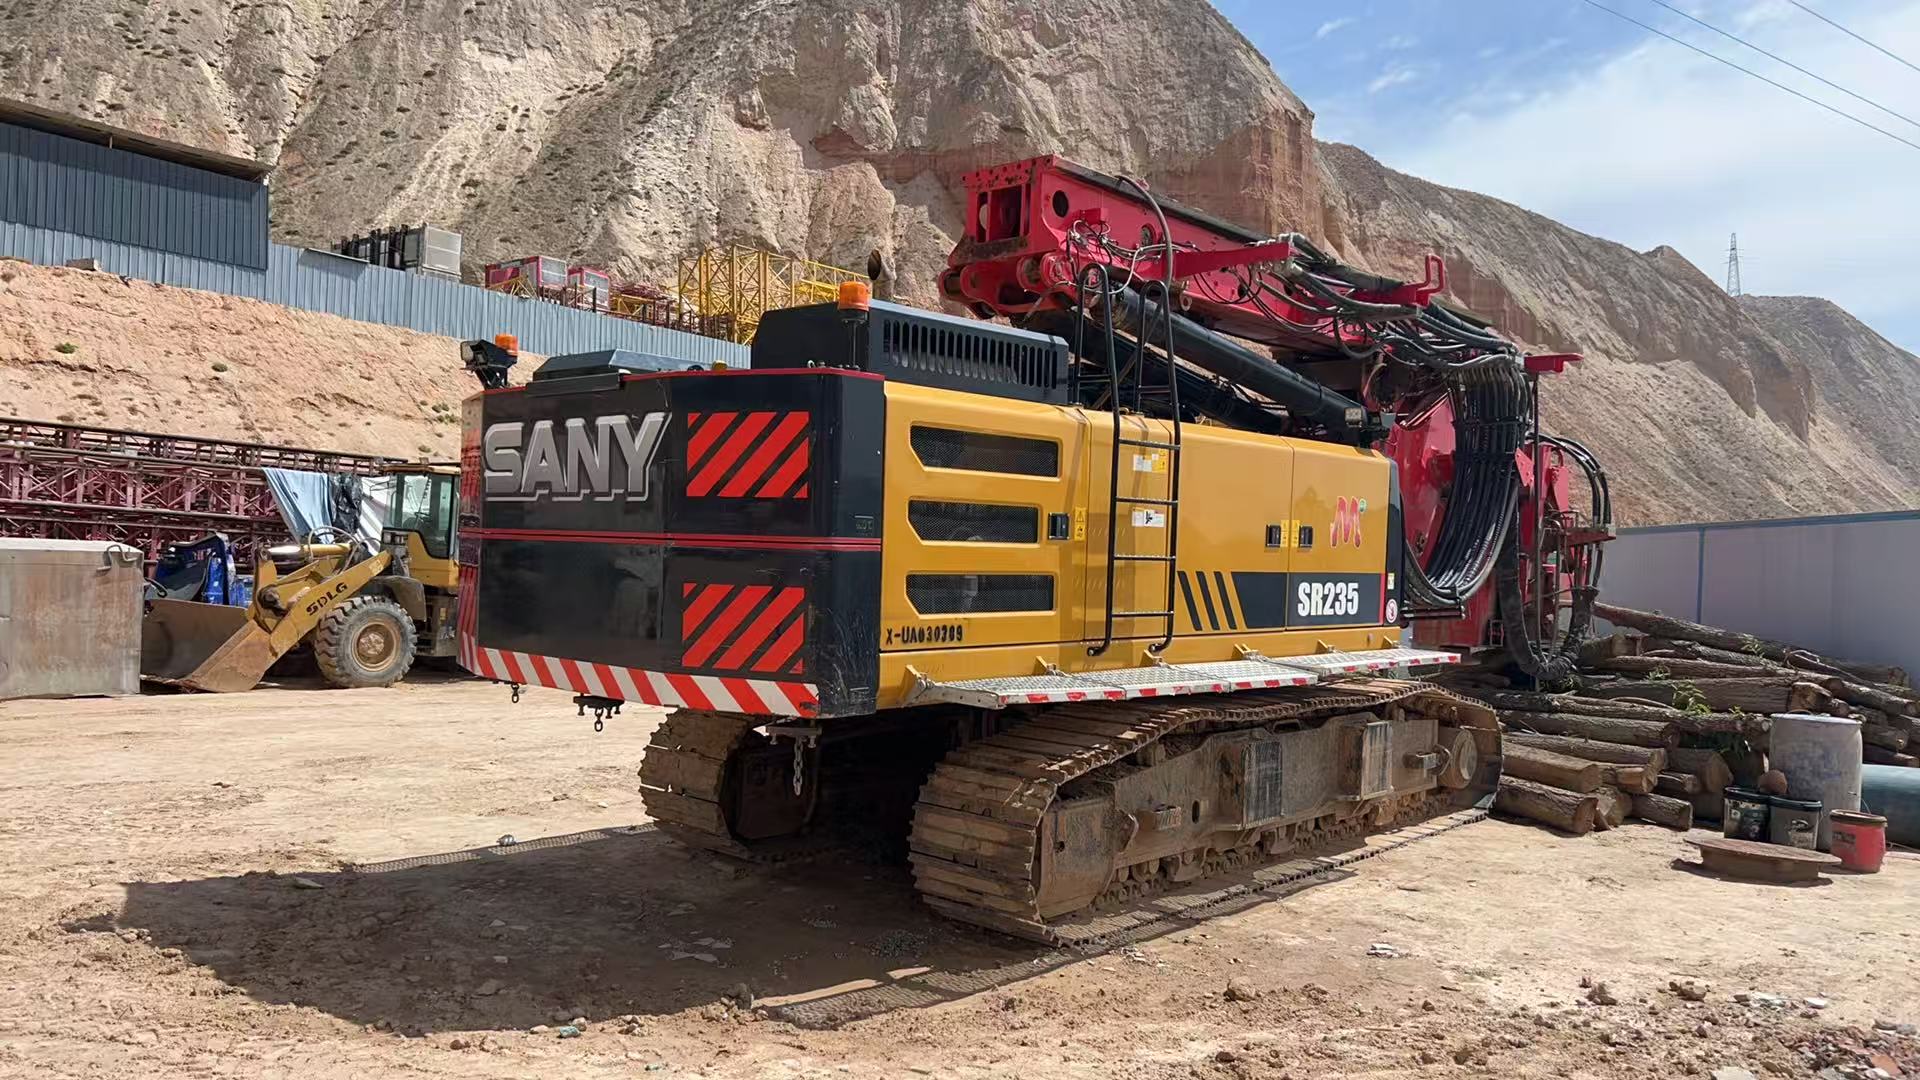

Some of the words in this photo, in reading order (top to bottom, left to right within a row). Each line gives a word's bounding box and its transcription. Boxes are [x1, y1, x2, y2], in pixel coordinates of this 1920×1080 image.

[484, 411, 673, 502] SANY
[306, 581, 348, 616] SDLG
[1297, 581, 1359, 617] SR235
